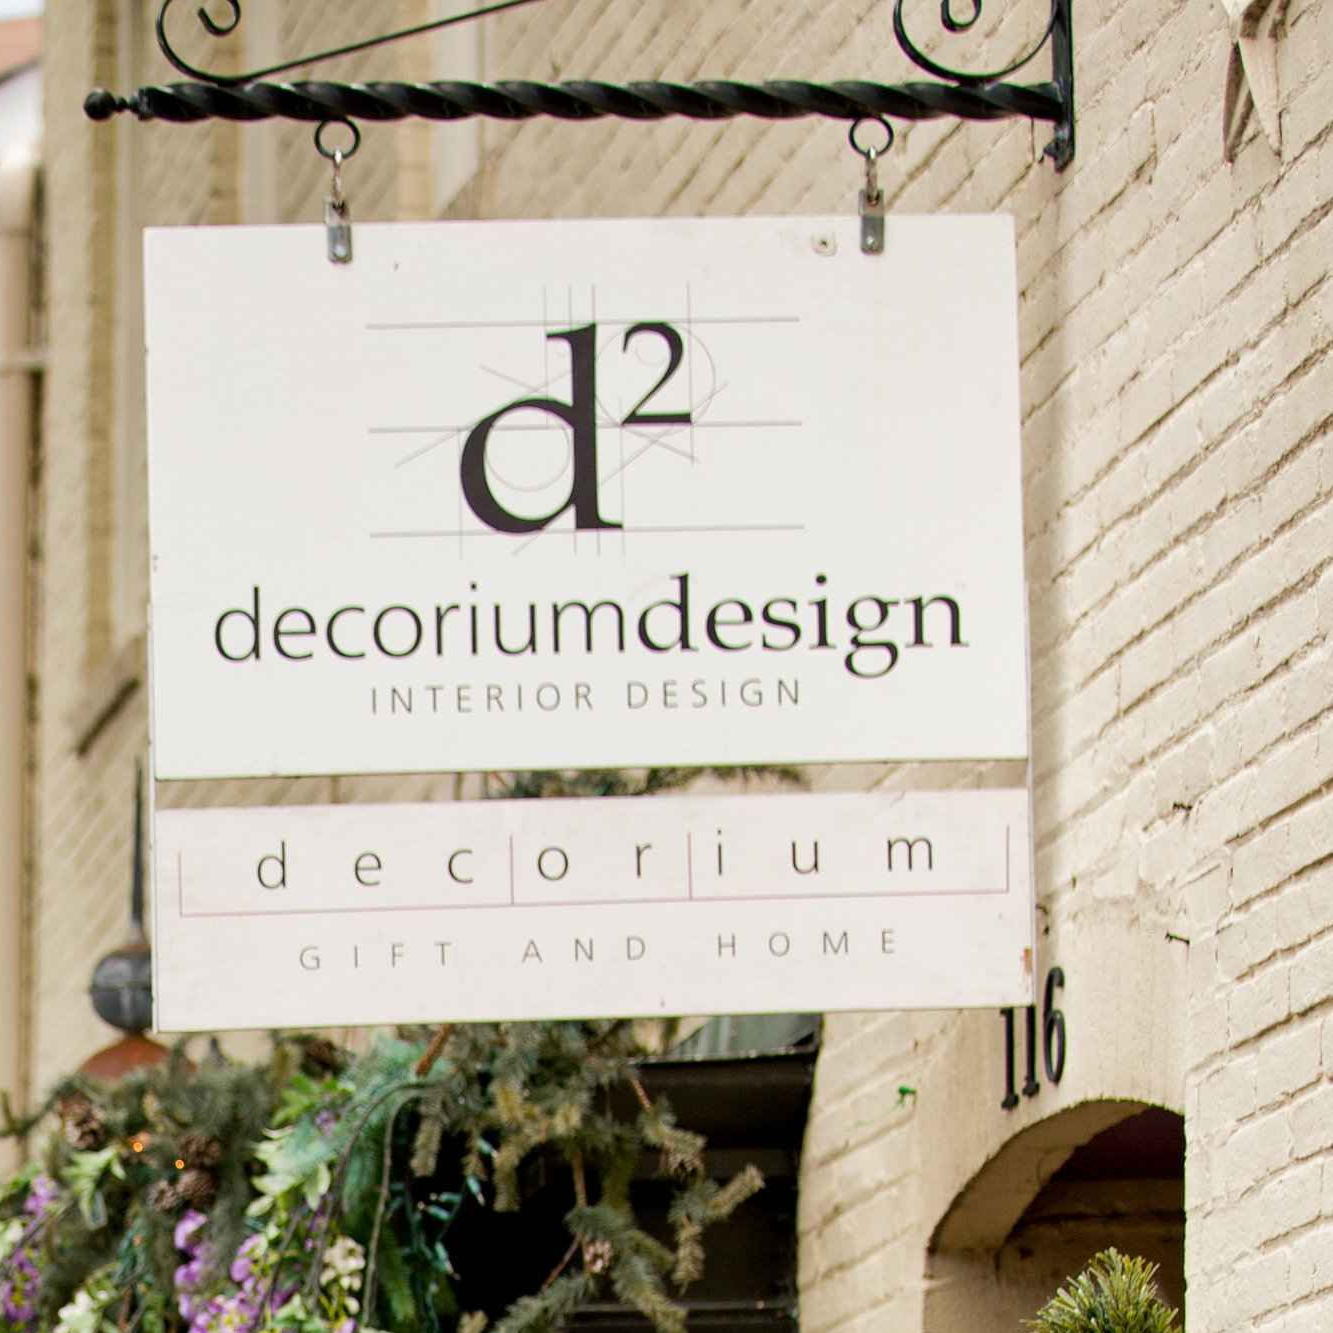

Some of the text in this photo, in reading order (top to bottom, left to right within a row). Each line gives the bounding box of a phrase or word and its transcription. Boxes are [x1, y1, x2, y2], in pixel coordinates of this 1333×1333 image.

[213, 572, 970, 680] decoriumdesign
[371, 678, 803, 715] INTERIOR DESIGN
[256, 828, 936, 890] decorium
[299, 929, 897, 971] GIFT AND HOME
[1000, 966, 1066, 1110] 116
